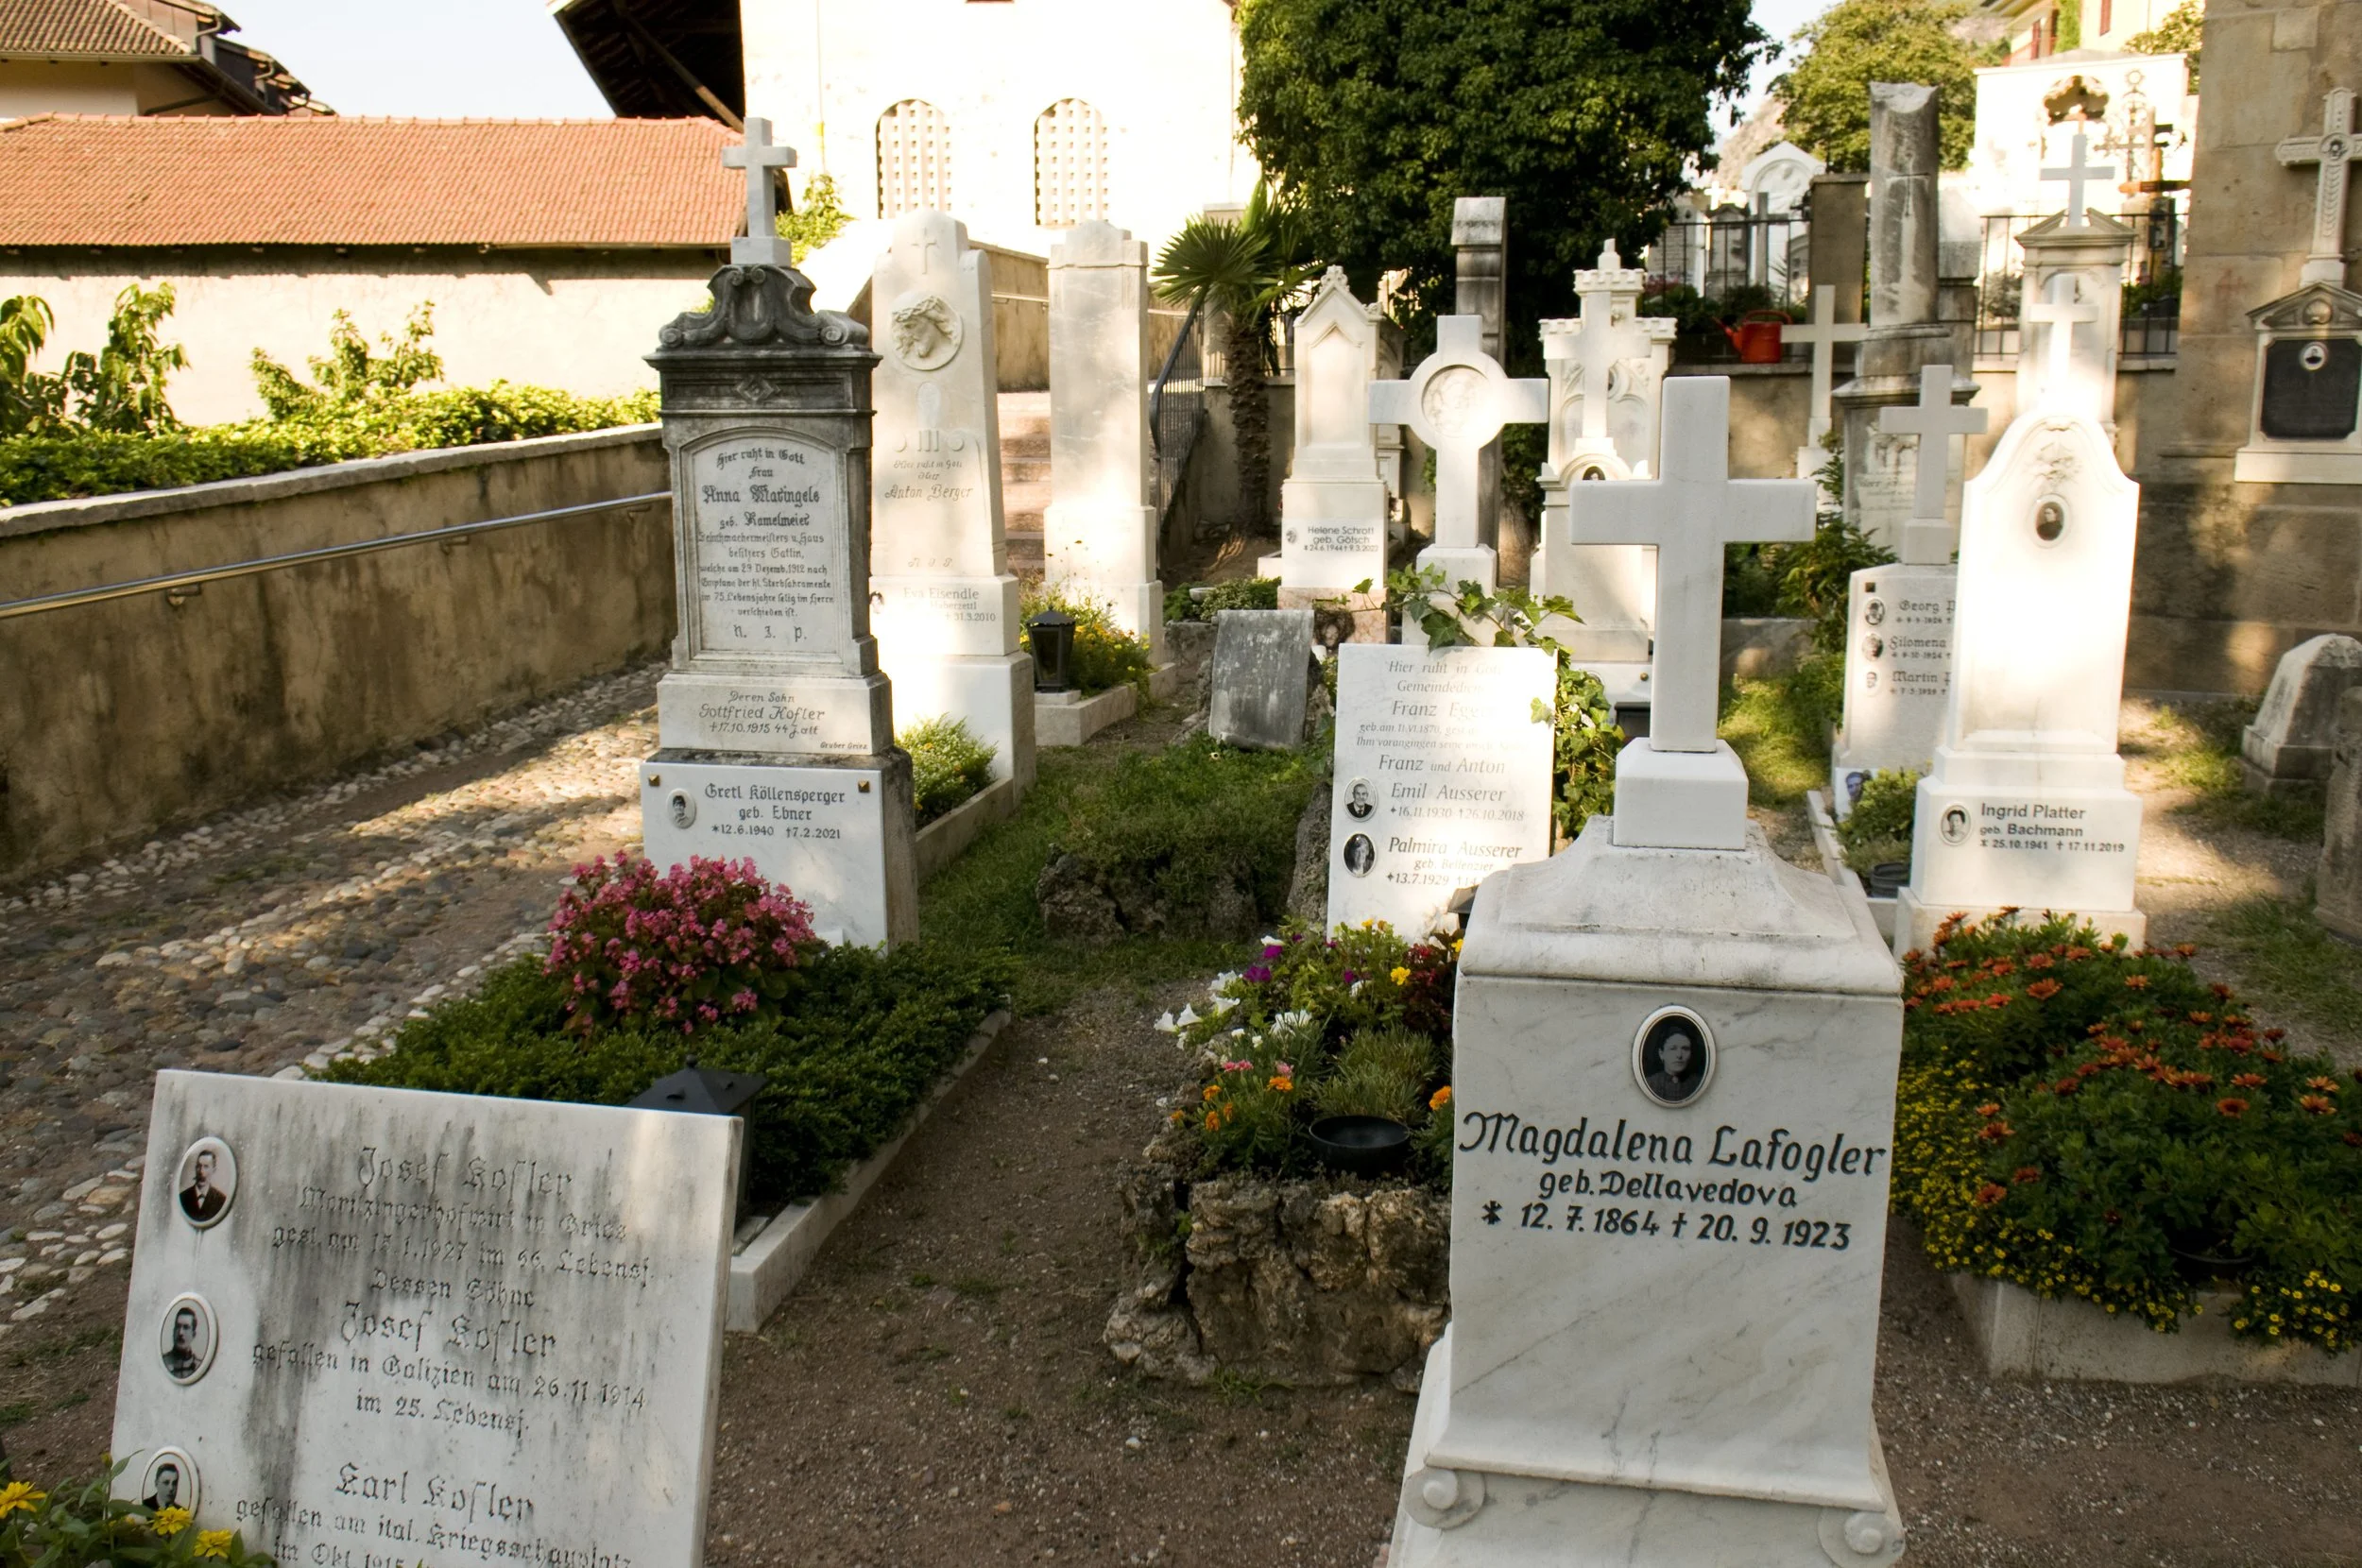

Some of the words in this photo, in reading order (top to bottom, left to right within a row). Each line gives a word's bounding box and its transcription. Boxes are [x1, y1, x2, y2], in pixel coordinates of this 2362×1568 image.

[741, 448, 762, 462] ruht
[765, 448, 775, 459] in
[779, 449, 806, 465] Gott
[748, 466, 774, 480] Frau
[701, 485, 742, 504] Anna
[926, 483, 974, 502] Berger
[1308, 525, 1340, 535] Helene
[1342, 525, 1375, 536] Schrott
[797, 593, 808, 603] im
[929, 586, 980, 600] Eisendle
[1899, 600, 1940, 614] Georg
[1889, 635, 1947, 651] Filomena
[1389, 660, 1414, 673] Hier
[1422, 660, 1447, 673] ruht
[1456, 660, 1468, 673] in
[1892, 670, 1938, 683] Martin
[727, 690, 764, 704] Deren
[768, 691, 796, 704] Sohn
[699, 703, 763, 724] Gottfried
[769, 706, 826, 724] Kofler
[1391, 700, 1438, 718] Franz
[775, 724, 788, 734] 44
[820, 741, 846, 750] Gruber
[1357, 737, 1376, 747] Ihm
[1377, 738, 1437, 751] vorangingen
[1378, 755, 1424, 772] Franz
[1430, 761, 1451, 773] und
[1456, 758, 1506, 775] Anton
[705, 783, 743, 800] Gretl
[749, 784, 846, 806] Köllensperger
[1391, 783, 1428, 799] Emil
[1437, 784, 1507, 802] Ausserer
[739, 806, 763, 821] geb.
[772, 805, 812, 821] Ebner
[1980, 802, 2028, 820] Ingrid
[2033, 804, 2086, 820] Platter
[721, 824, 775, 836] 12.6.1940
[793, 827, 841, 840] 7.2.2021
[2007, 823, 2084, 838] Bachmann
[1388, 837, 1448, 855] Palmira
[1458, 842, 1523, 859] Ausserer
[1992, 839, 2048, 850] 25.10.1941
[1395, 872, 1449, 886] 13.7.1929
[1459, 1111, 1693, 1166] Magdalena
[1707, 1124, 1888, 1184] Lafogler
[358, 1146, 450, 1198] Josef
[462, 1156, 573, 1206] Kofler
[1538, 1169, 1594, 1201] geb.
[1600, 1169, 1798, 1209] Dellavedova
[479, 1240, 505, 1266] im
[369, 1269, 452, 1299] Dessen
[464, 1278, 536, 1308] Söhne
[340, 1301, 434, 1353] Josef
[444, 1314, 557, 1363] Kofler
[252, 1339, 338, 1371] gefallen
[350, 1349, 369, 1373] in
[383, 1355, 473, 1389] Galizien
[488, 1374, 521, 1393] am
[355, 1389, 382, 1414] im
[395, 1396, 425, 1418] 25.
[334, 1461, 409, 1505] Karl
[422, 1474, 535, 1524] Kofler
[236, 1495, 323, 1527] gefallen
[334, 1514, 367, 1535] am
[378, 1514, 419, 1543] ital.
[272, 1535, 299, 1561] im
